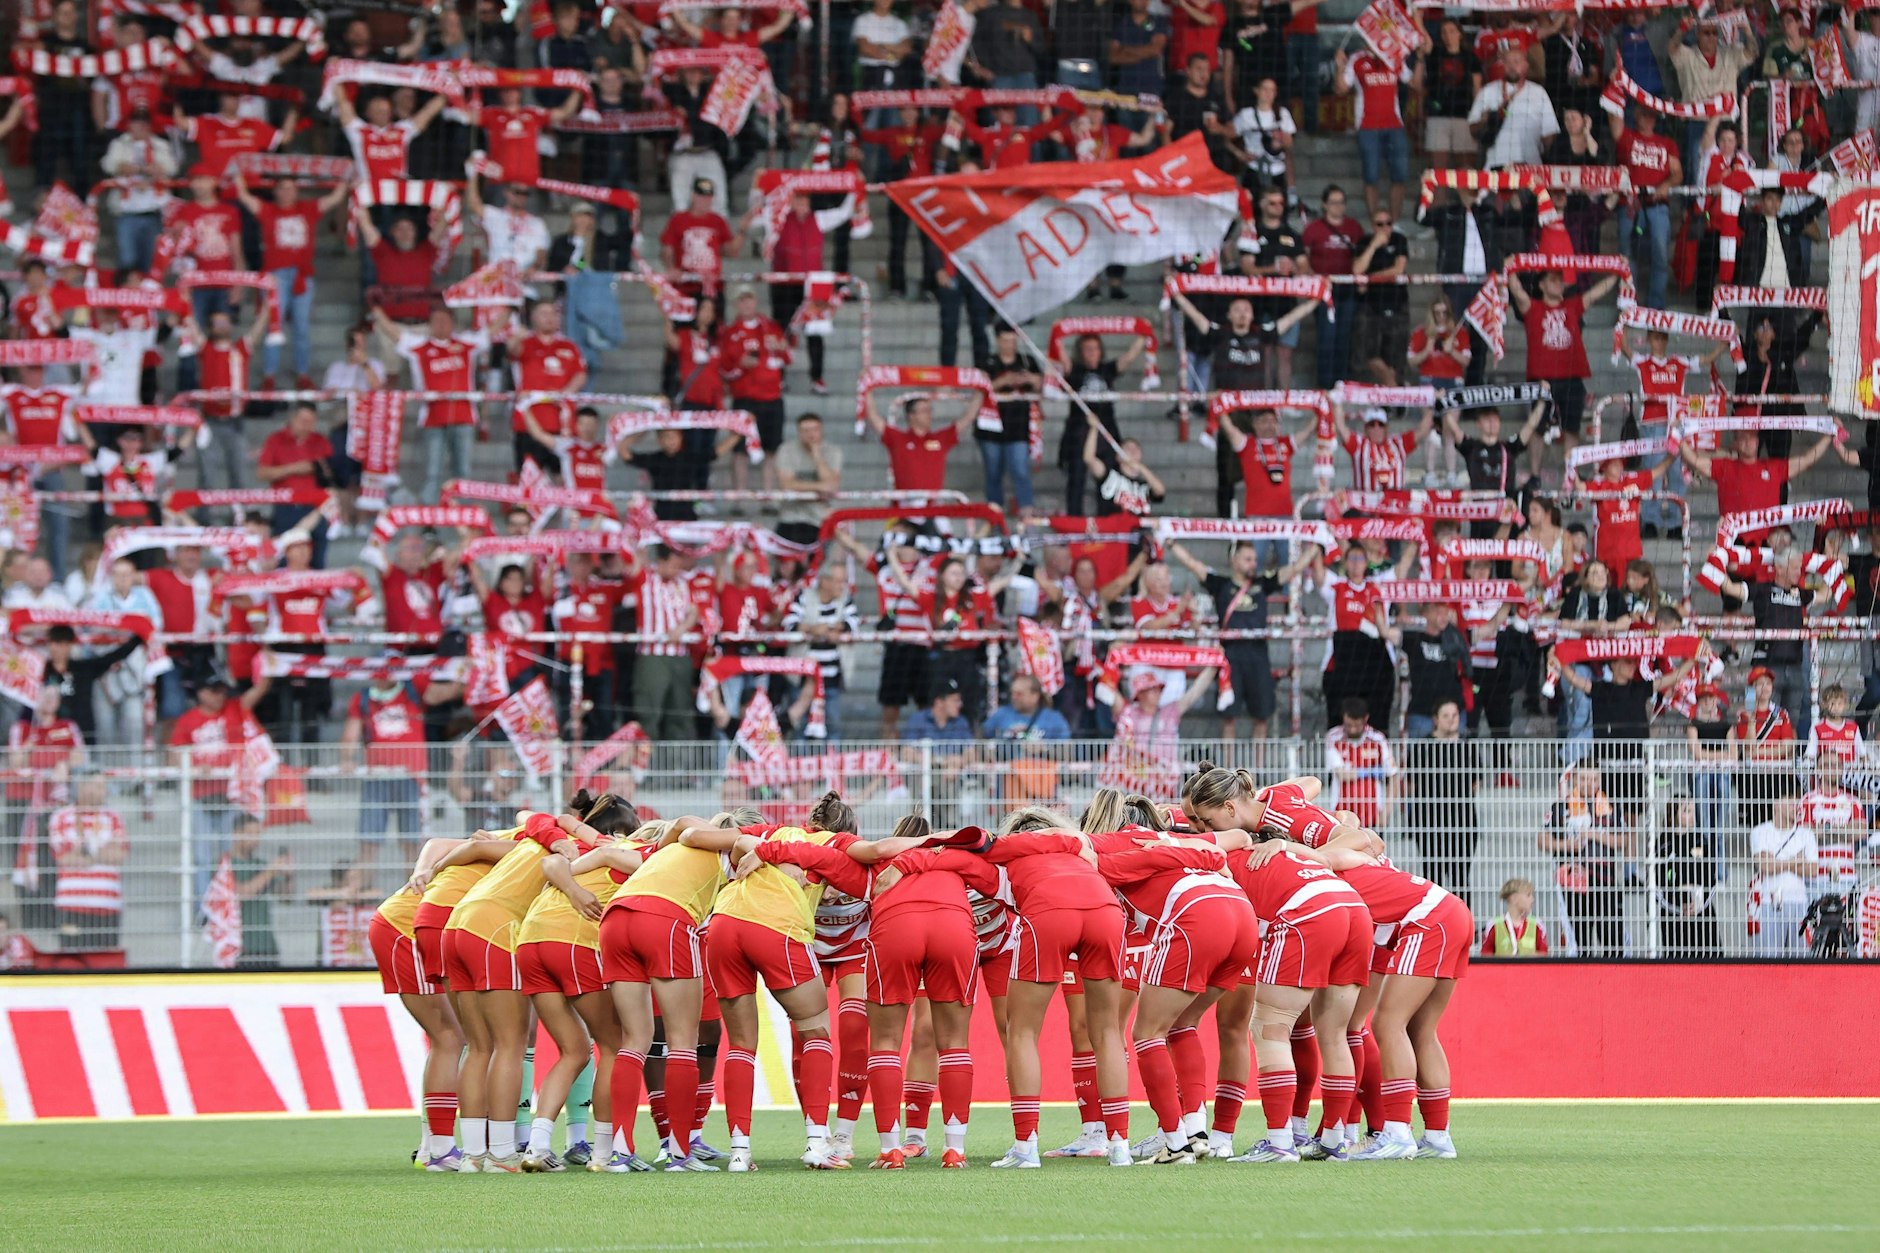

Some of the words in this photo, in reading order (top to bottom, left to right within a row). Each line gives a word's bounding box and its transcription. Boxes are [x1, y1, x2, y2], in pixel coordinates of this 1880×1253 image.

[1265, 276, 1321, 299] UNION
[1463, 386, 1515, 406] UNION
[1461, 538, 1502, 557] UNION
[1380, 582, 1442, 599] EISERN
[1448, 582, 1510, 599] UNION
[1586, 638, 1665, 657] UNIONER
